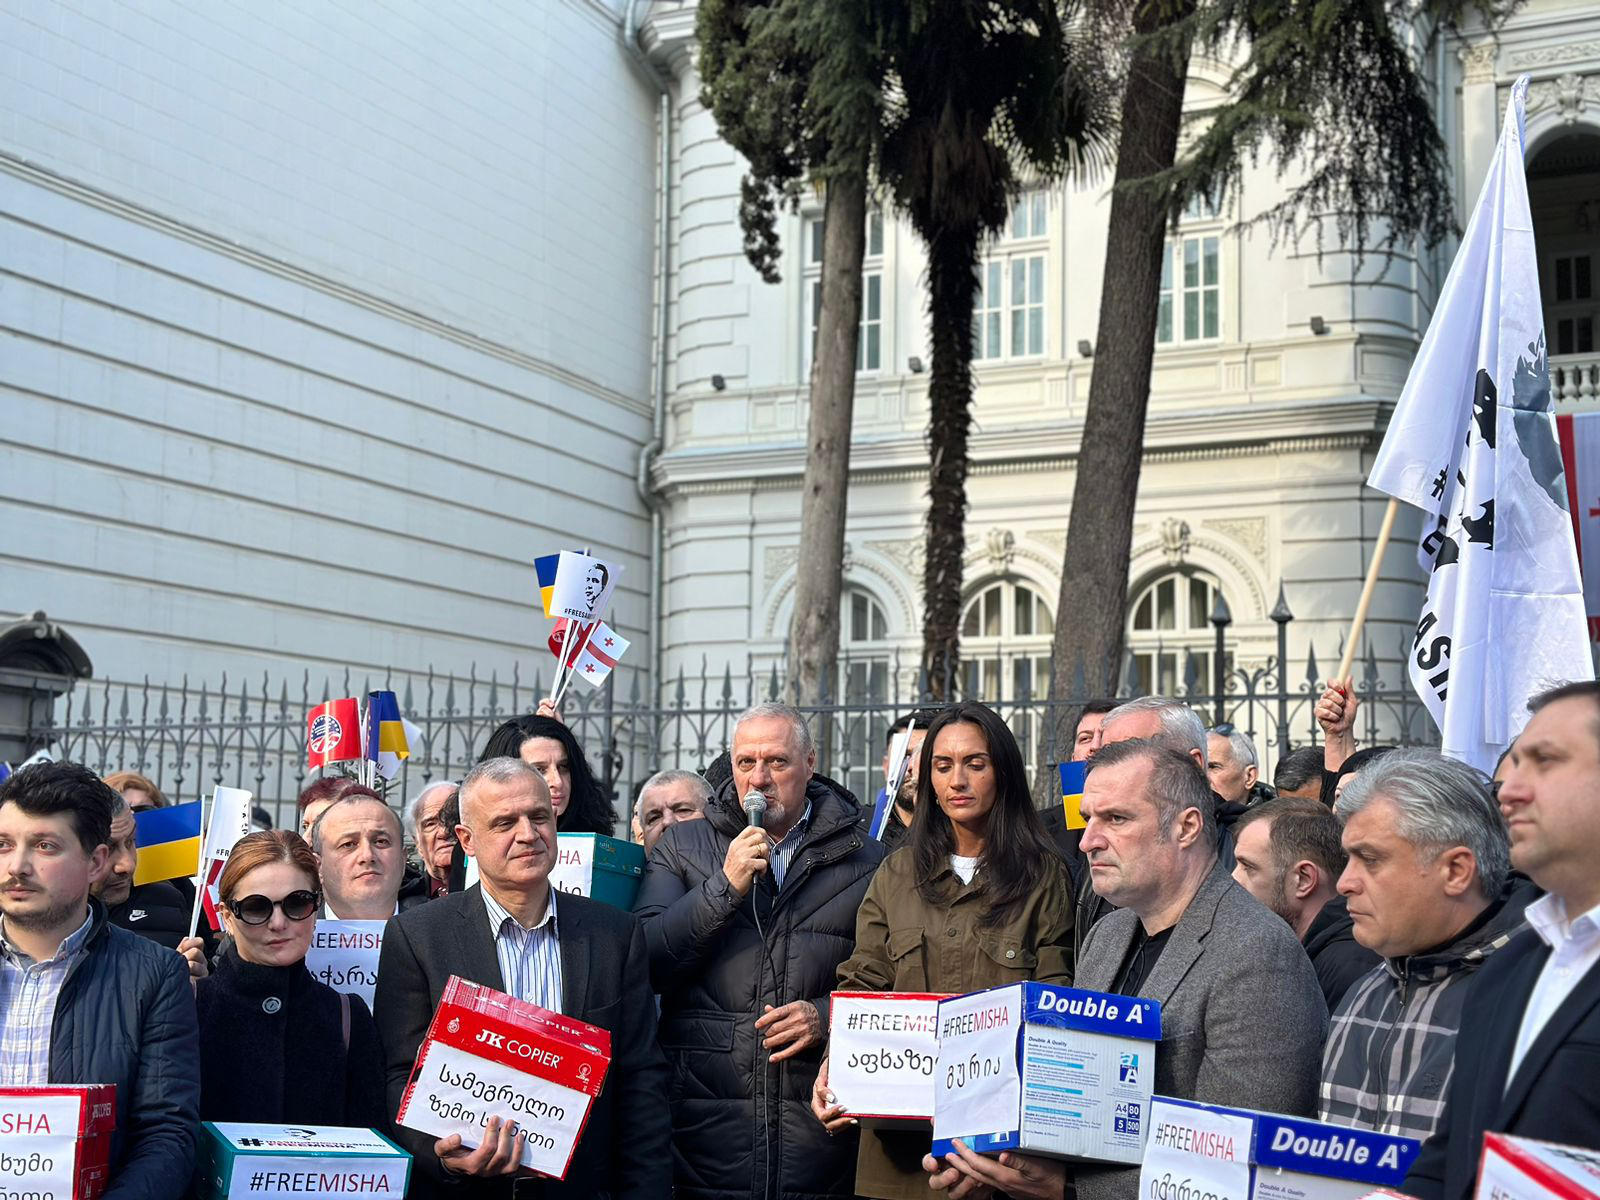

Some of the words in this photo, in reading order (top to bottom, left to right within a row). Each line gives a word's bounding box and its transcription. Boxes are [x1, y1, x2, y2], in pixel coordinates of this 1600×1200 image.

[1037, 990, 1119, 1021] Double
[942, 1006, 1009, 1039] #FREEMISHA
[474, 1028, 506, 1050] JK
[847, 1048, 939, 1076] აფხაზე
[946, 1053, 1001, 1089] გურია
[438, 1063, 566, 1122] სამეგრელო
[429, 1094, 476, 1124] ზემო
[1115, 1103, 1127, 1114] A4
[1128, 1105, 1140, 1116] 80
[1118, 1119, 1124, 1129] 5
[1127, 1121, 1140, 1132] 500
[1155, 1122, 1235, 1162] #FREEMISHA
[1271, 1126, 1370, 1165] Double
[250, 1172, 390, 1193] #FREEMISHA
